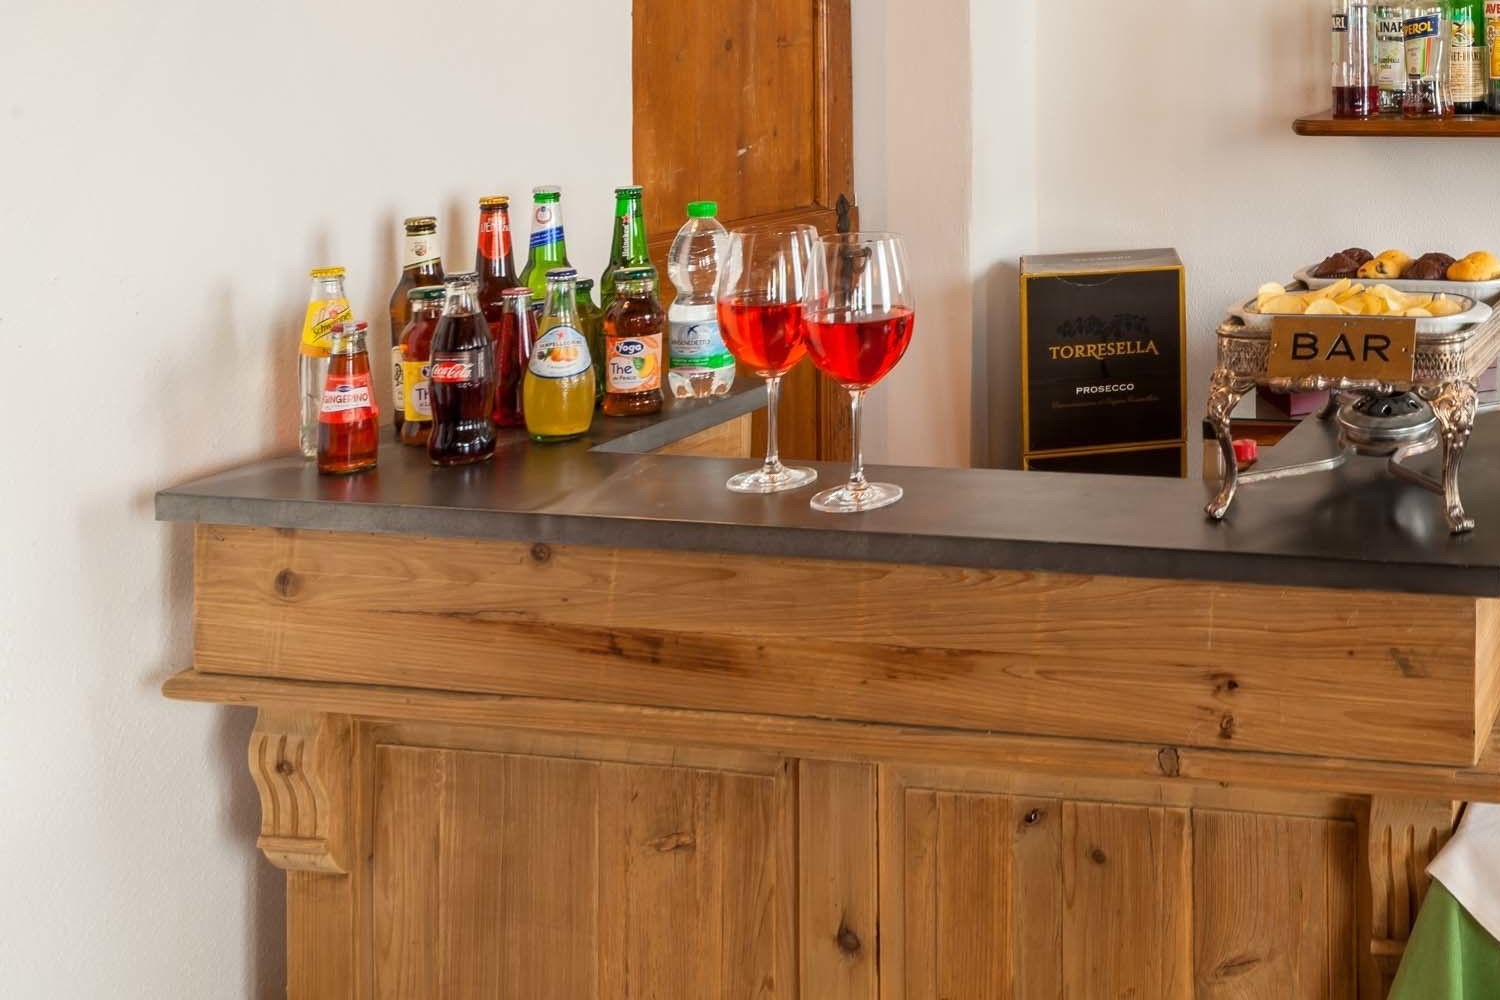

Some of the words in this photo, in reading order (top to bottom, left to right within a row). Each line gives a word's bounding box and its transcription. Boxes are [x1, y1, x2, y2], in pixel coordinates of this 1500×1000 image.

[616, 342, 643, 355] Yoga
[1048, 339, 1160, 361] TORRESELLA
[1291, 332, 1392, 362] BAR
[611, 362, 633, 375] The
[1076, 382, 1135, 396] PROSECCO
